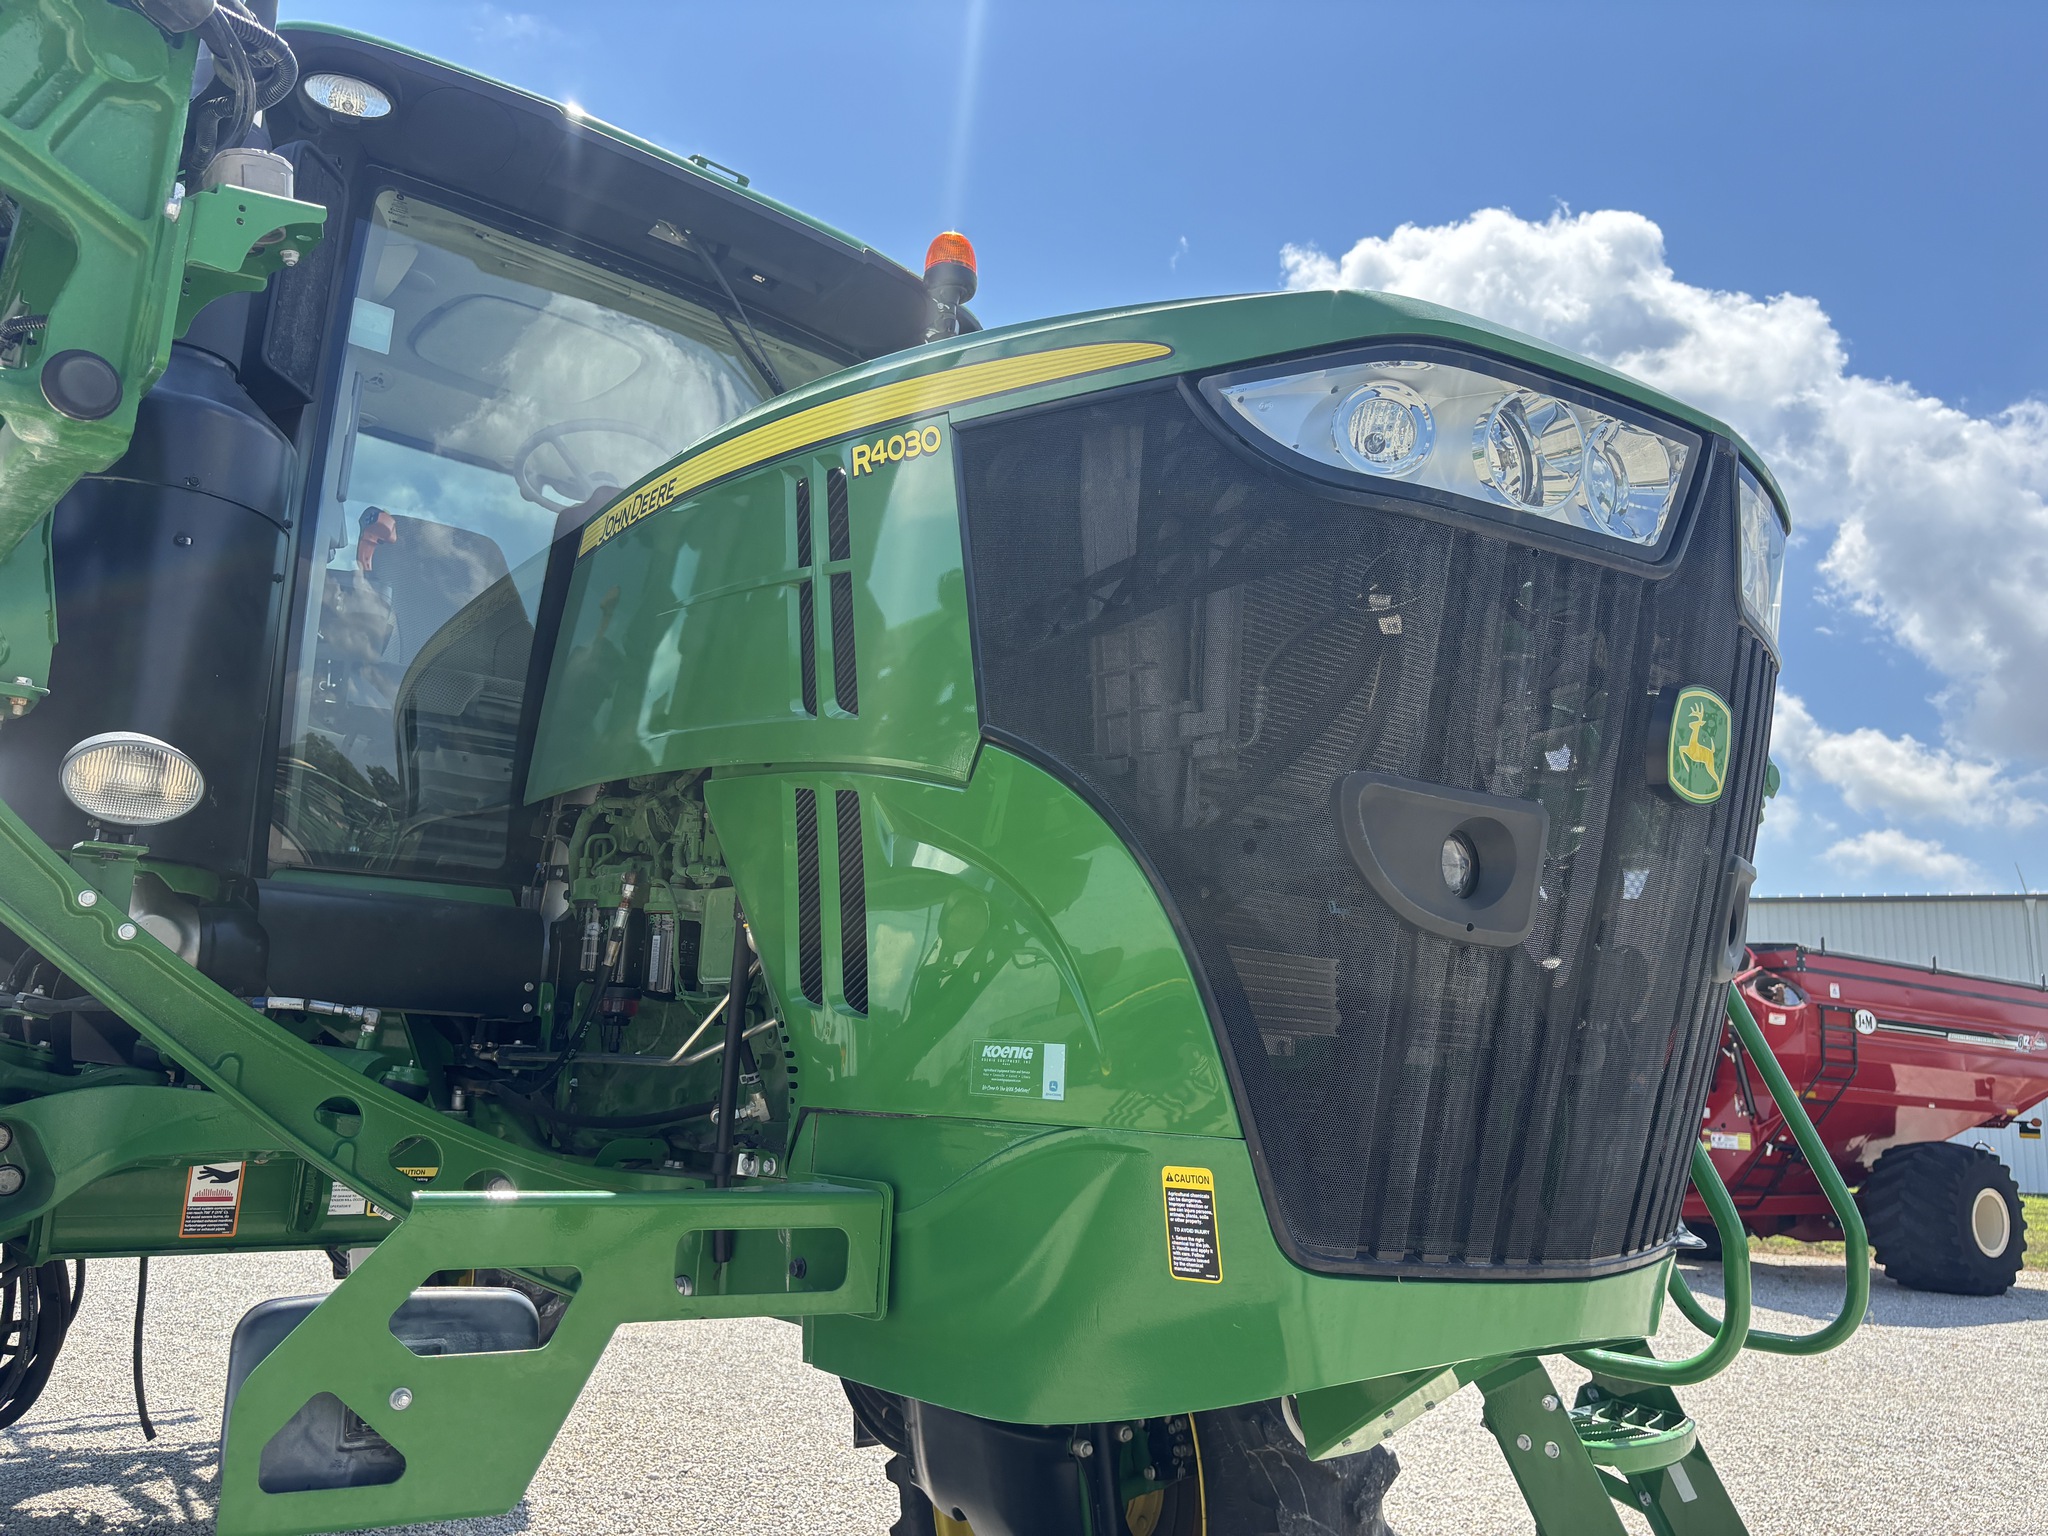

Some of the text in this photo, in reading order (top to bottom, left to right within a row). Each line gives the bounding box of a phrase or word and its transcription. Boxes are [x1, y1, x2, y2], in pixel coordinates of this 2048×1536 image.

[851, 424, 942, 480] R4030
[598, 476, 678, 543] JOHN DEERE
[1174, 1174, 1210, 1184] CAUTION
